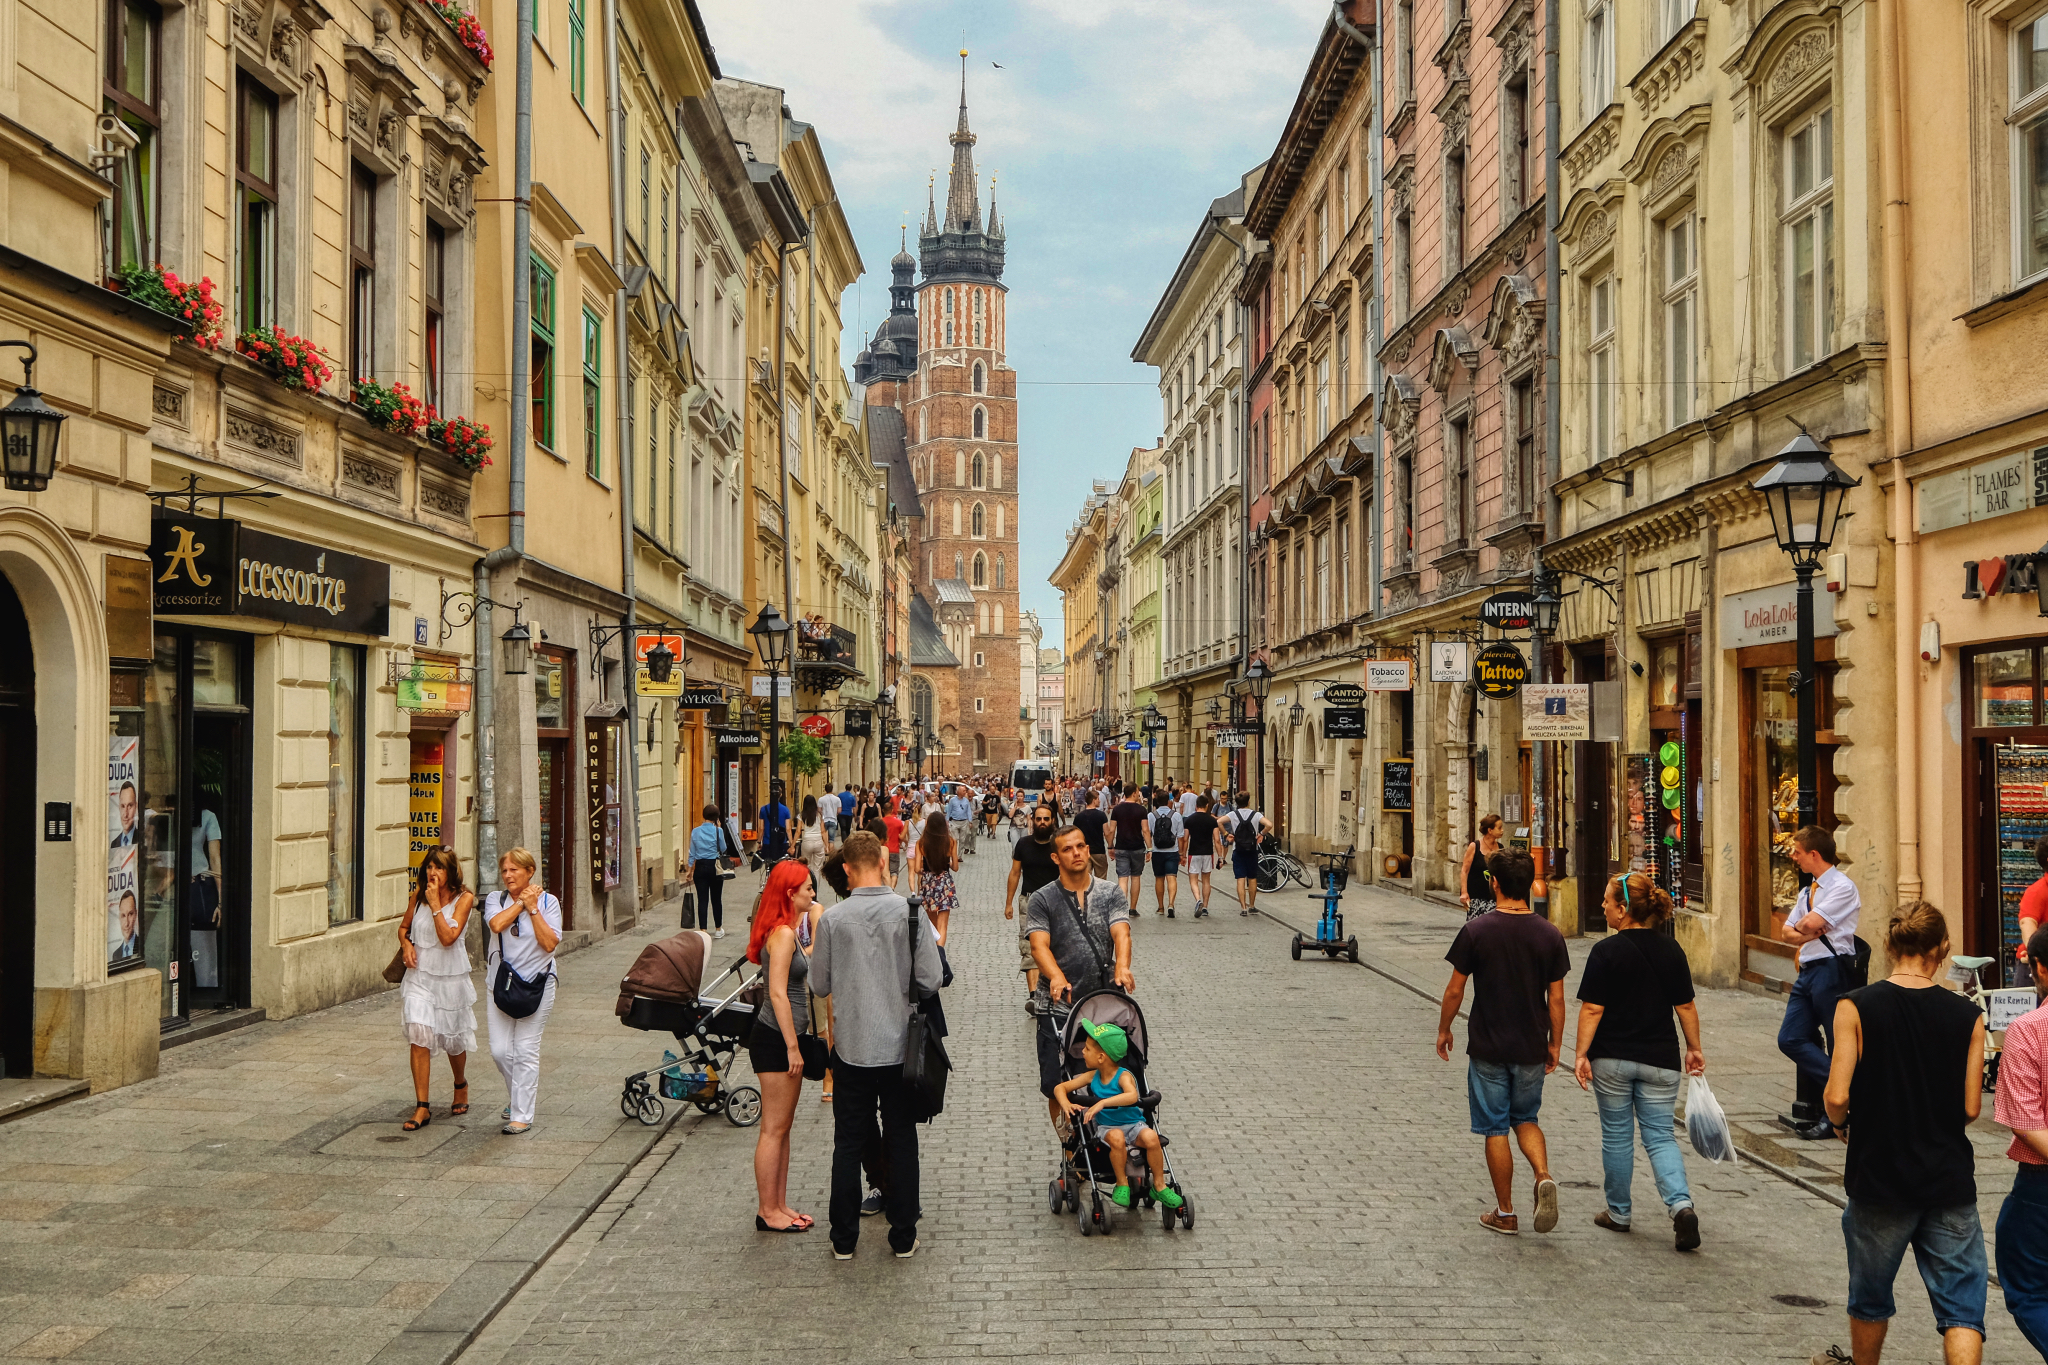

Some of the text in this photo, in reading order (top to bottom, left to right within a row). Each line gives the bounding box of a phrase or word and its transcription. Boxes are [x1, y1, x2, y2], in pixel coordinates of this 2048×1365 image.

[9, 434, 28, 457] 31
[1974, 465, 2021, 495] FLAMES
[1986, 490, 2010, 513] BAR
[239, 553, 346, 615] ccessorize
[1484, 602, 1533, 617] INTERN
[1509, 617, 1529, 628] cafe
[1760, 626, 1787, 638] AMBER
[1482, 651, 1516, 660] piercing
[1370, 667, 1405, 676] Tobacco
[1476, 660, 1525, 681] Tattoo
[1327, 689, 1365, 697] KANTOR
[680, 694, 717, 704] RYŁKO
[1753, 720, 1798, 740] AMBE
[719, 734, 759, 744] Alkohole
[1216, 732, 1246, 747] TATTOO
[1096, 751, 1103, 760] P
[109, 762, 134, 780] DUDA
[410, 772, 441, 783] RMS
[1384, 787, 1405, 799] Polish
[1390, 798, 1411, 808] Vodka
[410, 812, 438, 823] VATE
[409, 826, 441, 837] BLES
[108, 871, 134, 893] DUDA
[1994, 996, 2031, 1005] Bike Rental
